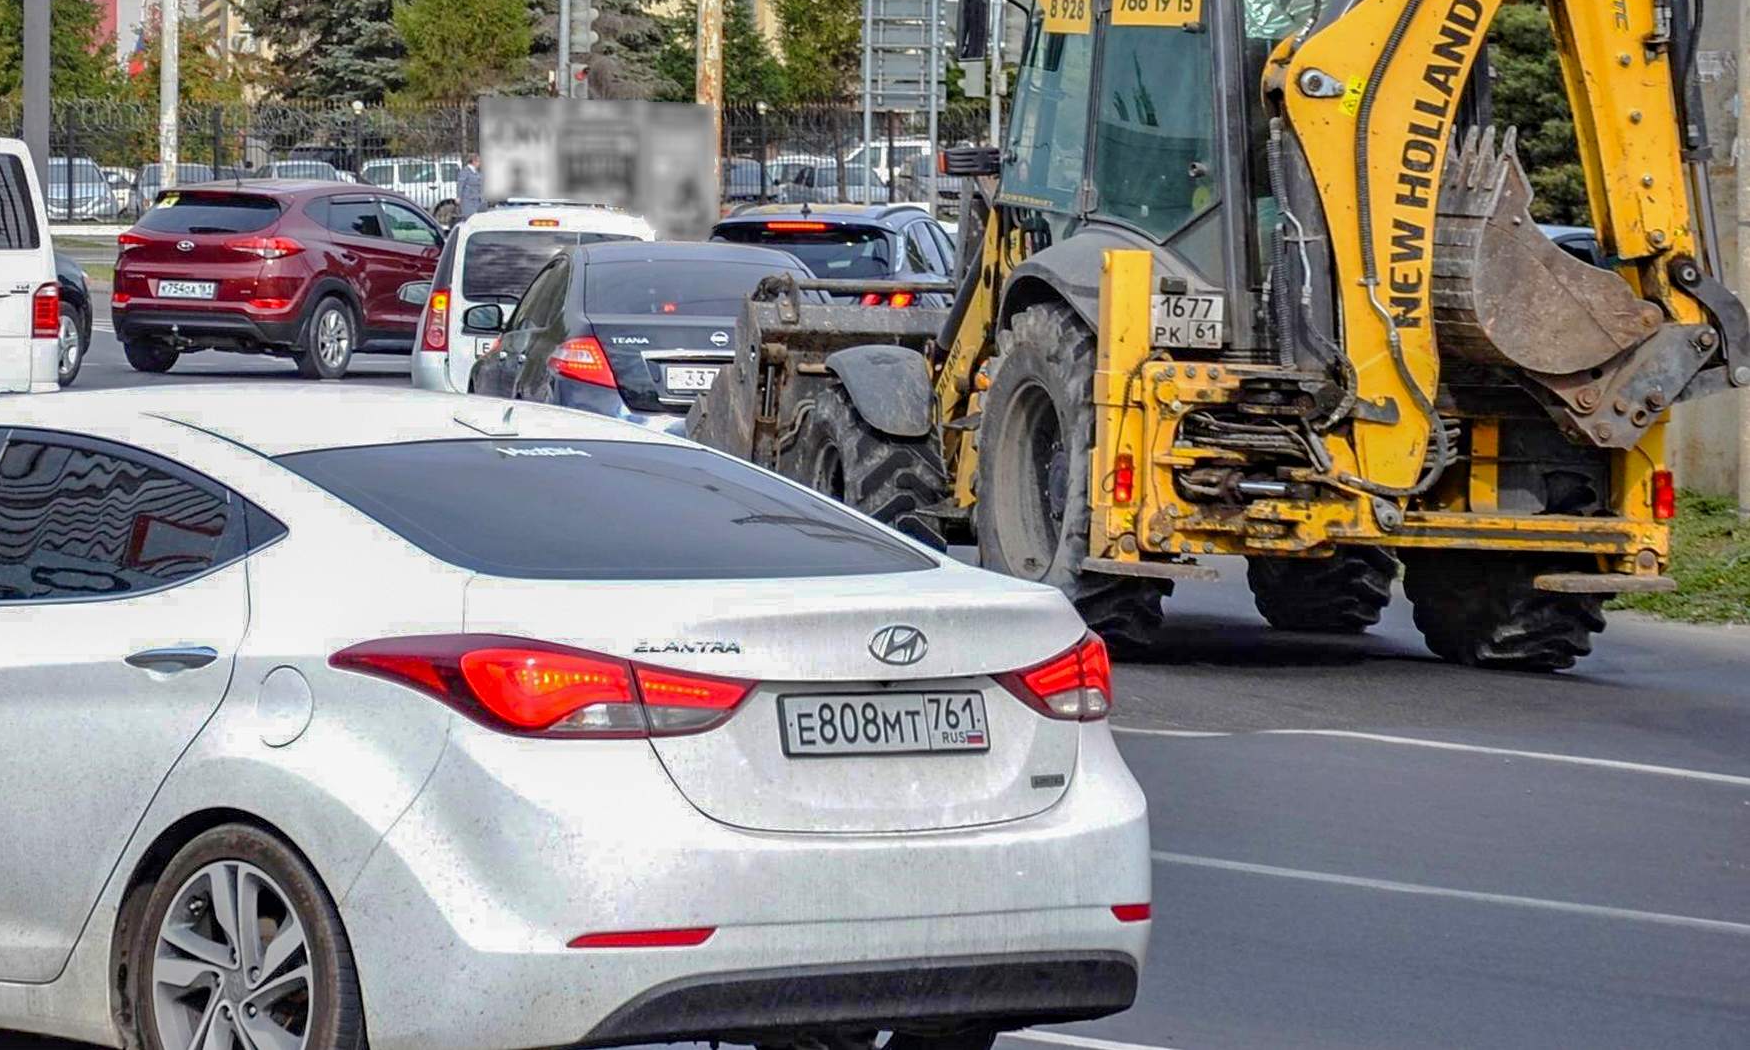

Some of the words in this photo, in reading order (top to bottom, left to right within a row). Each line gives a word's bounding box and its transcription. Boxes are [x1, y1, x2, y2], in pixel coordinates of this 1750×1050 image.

[1388, 218, 1424, 329] NEW
[1161, 296, 1213, 319] 1677
[611, 336, 650, 345] TEANA
[1155, 326, 1181, 343] РК
[1195, 323, 1217, 339] 61
[633, 641, 741, 654] ELANTRA
[797, 701, 921, 746] Е808МТ
[927, 697, 977, 731] 761
[942, 731, 966, 744] RUS
